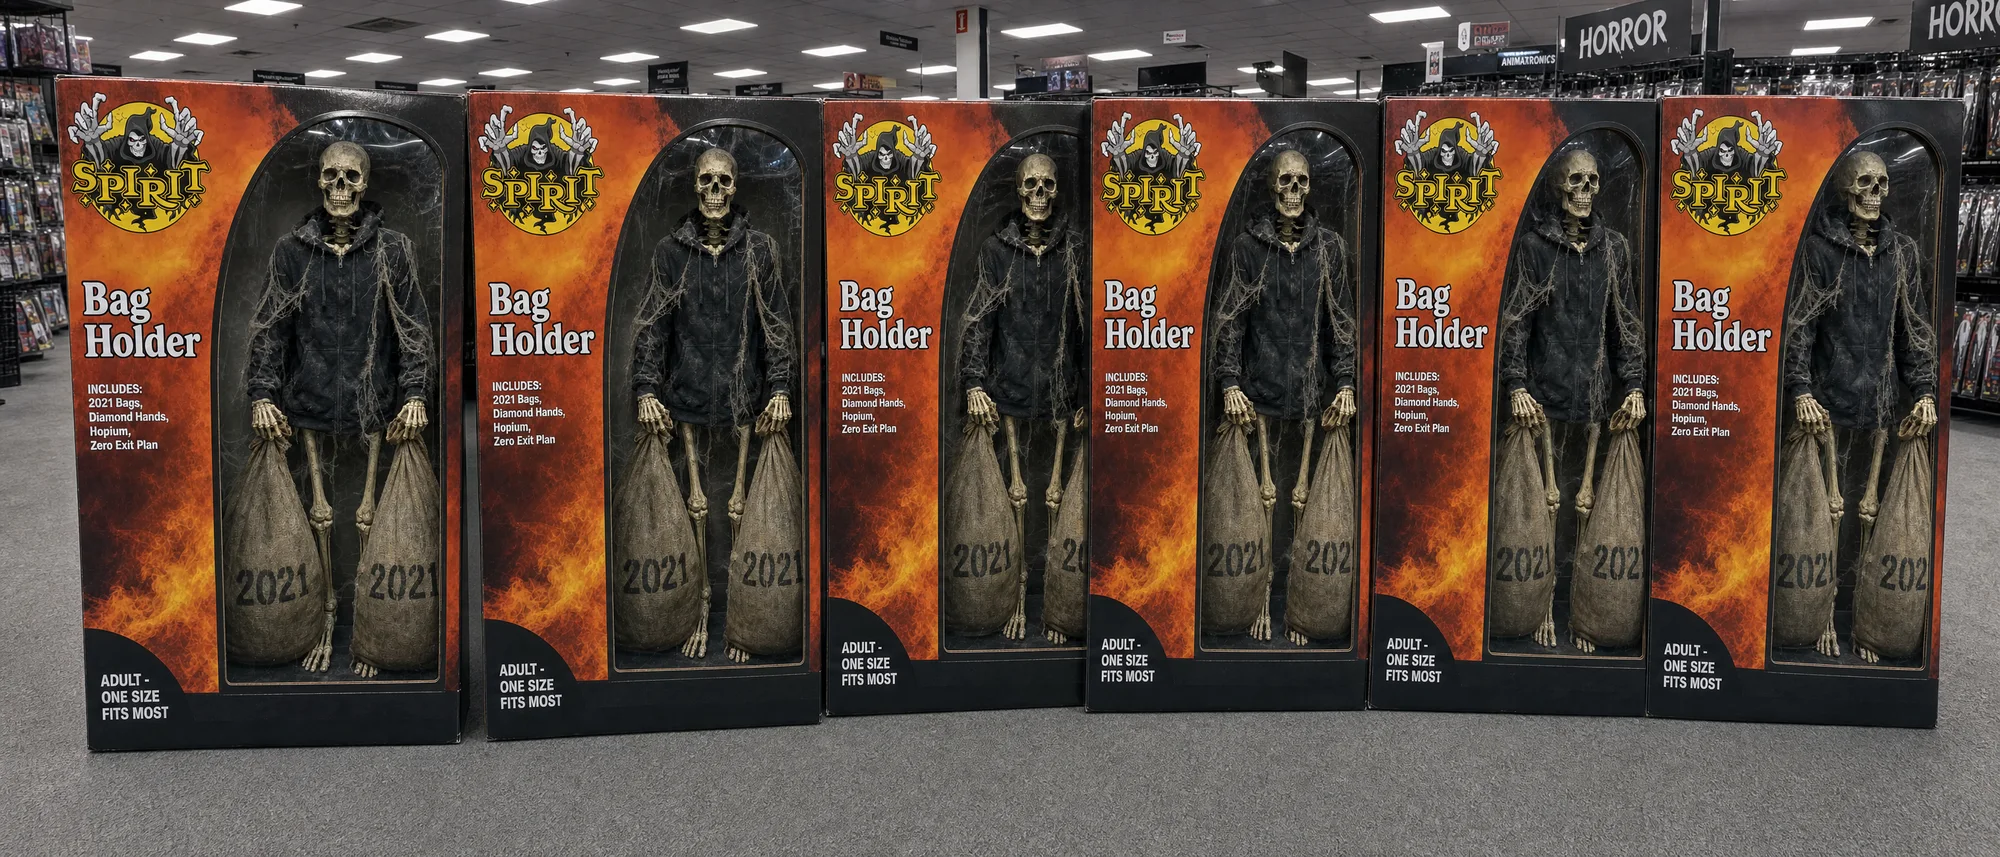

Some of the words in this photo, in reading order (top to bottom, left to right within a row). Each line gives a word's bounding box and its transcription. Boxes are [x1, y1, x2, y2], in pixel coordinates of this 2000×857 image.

[1579, 9, 1667, 59] HORROR
[1501, 54, 1555, 66] ANIMATRONICS
[71, 159, 211, 210] SPIRIT
[480, 166, 605, 214] SPIRIT
[1100, 168, 1206, 214] SPIRIT
[1393, 168, 1504, 214] SPIRIT
[833, 171, 943, 216] SPIRIT
[1670, 168, 1788, 216] SPIRIT
[82, 281, 151, 324] Bag
[488, 282, 551, 323] Bag
[839, 279, 894, 319] Bag
[1104, 279, 1158, 318] Bag
[1396, 278, 1451, 318] Bag
[1672, 279, 1731, 320] Bag
[489, 322, 596, 356] Holder
[840, 317, 933, 350] Holder
[1103, 317, 1195, 350] Holder
[1394, 317, 1488, 350] Holder
[1672, 318, 1772, 353] Holder
[84, 323, 202, 359] Holder
[842, 373, 886, 382] INCLUDES:
[1105, 372, 1148, 382] INCLUDES:
[1395, 371, 1440, 381] INCLUDES:
[1672, 374, 1720, 384] INCLUDES:
[87, 383, 142, 395] INCLUDES:
[492, 380, 542, 392] INCLUDES:
[842, 386, 862, 395] 2021
[863, 386, 886, 396] Bags,
[1105, 385, 1125, 394] 2021
[1126, 385, 1148, 396] Bags,
[1395, 384, 1415, 394] 2021
[1417, 384, 1440, 396] Bags,
[1672, 387, 1693, 397] 2021
[1695, 387, 1719, 399] Bags,
[88, 397, 113, 408] 2021
[116, 397, 143, 410] Bags,
[493, 394, 515, 405] 2021
[517, 394, 542, 406] Bags,
[842, 398, 877, 408] Diamond
[879, 397, 906, 409] Hands,
[1105, 398, 1140, 408] Diamond
[1141, 398, 1168, 408] Hands,
[1394, 397, 1431, 407] Diamond
[1432, 397, 1460, 408] Hands,
[1672, 400, 1710, 410] Diamond
[1711, 400, 1741, 413] Hands,
[89, 411, 133, 422] Diamond
[135, 411, 169, 423] Hands,
[493, 407, 534, 419] Diamond
[535, 407, 566, 418] Hands,
[842, 411, 876, 422] Hopium,
[1105, 411, 1138, 422] Hopium,
[1394, 410, 1428, 421] Hopium,
[1671, 413, 1708, 425] Hopium,
[89, 425, 132, 438] Hopium,
[493, 422, 531, 434] Hopium,
[841, 424, 861, 434] Zero
[862, 424, 878, 433] Exit
[879, 423, 897, 433] Plan
[1105, 423, 1123, 433] Zero
[1125, 423, 1140, 433] Exit
[1141, 423, 1159, 433] Plan
[1394, 423, 1413, 432] Zero
[1415, 423, 1430, 433] Exit
[1432, 423, 1449, 433] Plan
[1671, 426, 1691, 436] Zero
[1693, 427, 1710, 437] Exit
[1711, 427, 1730, 437] Plan
[90, 440, 113, 451] Zero
[115, 440, 135, 450] Exit
[137, 439, 158, 450] Plan
[494, 436, 515, 446] Zero
[517, 435, 534, 446] Exit
[536, 434, 556, 445] Plan
[953, 538, 1012, 578] 2021
[1207, 538, 1264, 577] 2021
[1496, 542, 1550, 582] 2021
[622, 552, 689, 594] 2021
[742, 550, 803, 588] 2021
[1777, 550, 1833, 590] 2021
[236, 563, 309, 606] 2021
[369, 561, 439, 601] 2021
[841, 641, 876, 654] ADULT
[1101, 638, 1135, 650] ADULT
[1386, 637, 1422, 650] ADULT
[1664, 643, 1701, 657] ADULT
[841, 657, 864, 670] ONE
[866, 657, 890, 670] SIZE
[1101, 654, 1123, 666] ONE
[1125, 654, 1148, 666] SIZE
[1386, 653, 1409, 666] ONE
[1411, 654, 1435, 667] SIZE
[1663, 659, 1687, 673] ONE
[1690, 660, 1715, 674] SIZE
[499, 662, 538, 677] ADULT
[1101, 670, 1123, 682] FITS
[1125, 670, 1155, 682] MOST
[1386, 669, 1408, 681] FITS
[1411, 670, 1442, 683] MOST
[100, 673, 142, 687] ADULT
[500, 680, 525, 693] ONE
[528, 678, 554, 692] SIZE
[841, 673, 864, 686] FITS
[867, 672, 897, 685] MOST
[1663, 675, 1687, 688] FITS
[1690, 677, 1722, 690] MOST
[101, 690, 128, 704] ONE
[131, 689, 160, 703] SIZE
[500, 696, 526, 710] FITS
[528, 694, 563, 708] MOST
[102, 707, 129, 720] FITS
[132, 706, 169, 720] MOST
